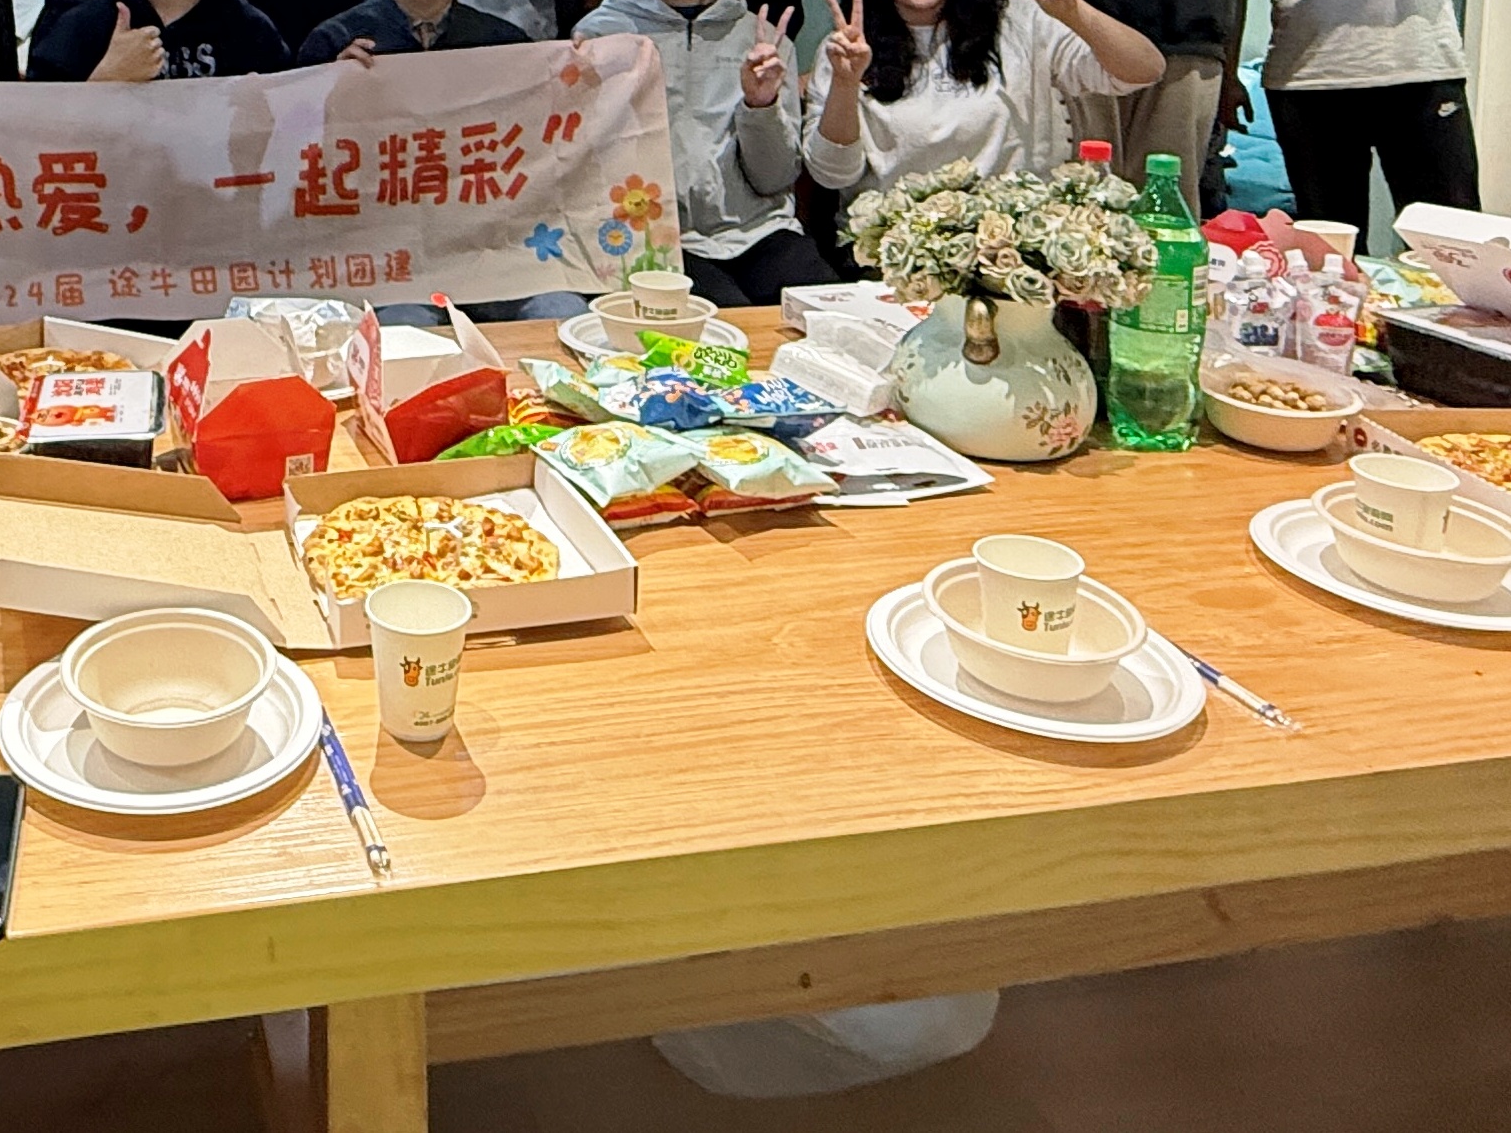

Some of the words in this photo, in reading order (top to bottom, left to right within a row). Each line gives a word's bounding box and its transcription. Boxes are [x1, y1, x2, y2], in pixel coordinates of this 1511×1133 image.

[108, 249, 413, 298] 途牛田园计划团建
